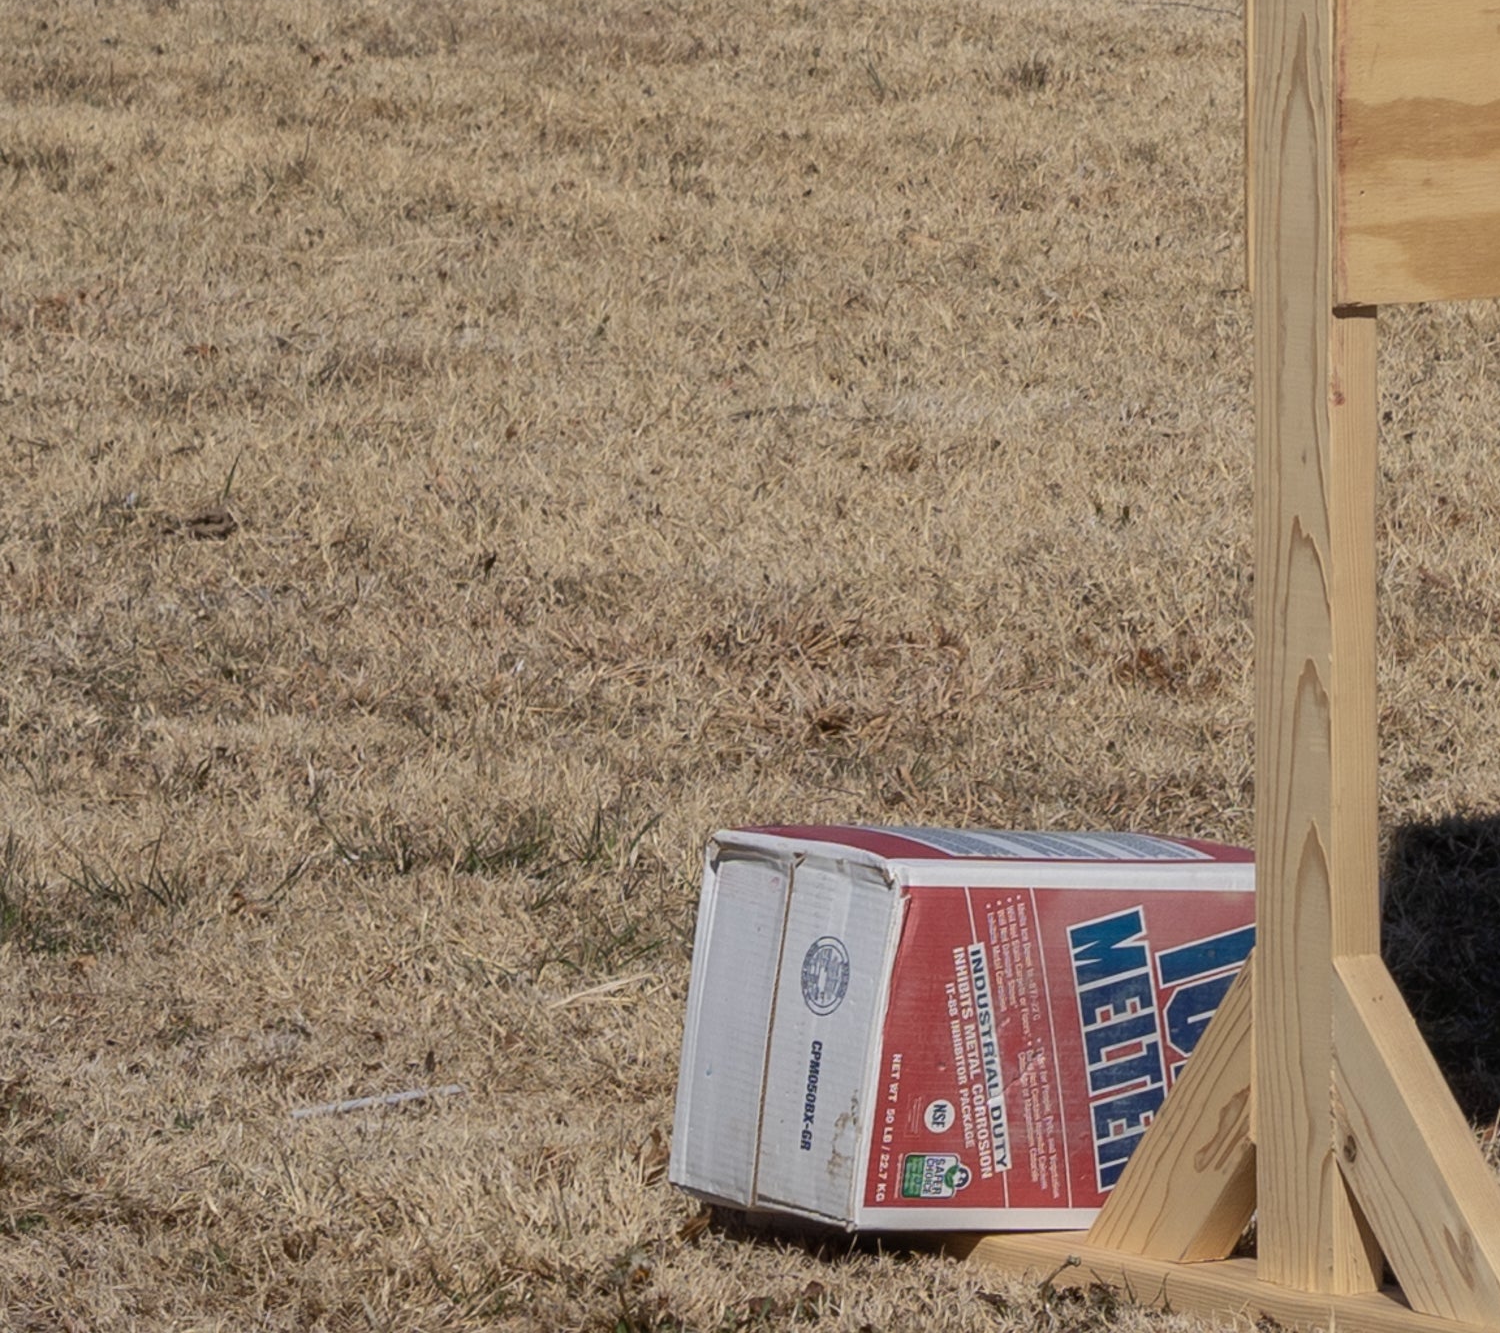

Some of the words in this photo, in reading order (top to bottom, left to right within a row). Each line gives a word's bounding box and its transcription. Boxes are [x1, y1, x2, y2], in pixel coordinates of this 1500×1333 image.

[952, 946, 972, 1019] INHIBITS
[891, 1053, 901, 1079] NET
[963, 1023, 980, 1080] METAL
[969, 948, 999, 1097] INDUSTRIAL
[989, 1106, 1007, 1168] DUTY
[887, 1082, 898, 1101] WT
[885, 1108, 894, 1123] 50
[931, 1104, 946, 1127] NSF
[957, 1088, 975, 1148] PACKAGE
[970, 1083, 992, 1178] CORROSION
[882, 1126, 893, 1143] LB
[878, 1153, 889, 1179] 22.7
[922, 1159, 932, 1194] CHOICE
[933, 1158, 944, 1194] SAFER
[875, 1183, 885, 1201] KG
